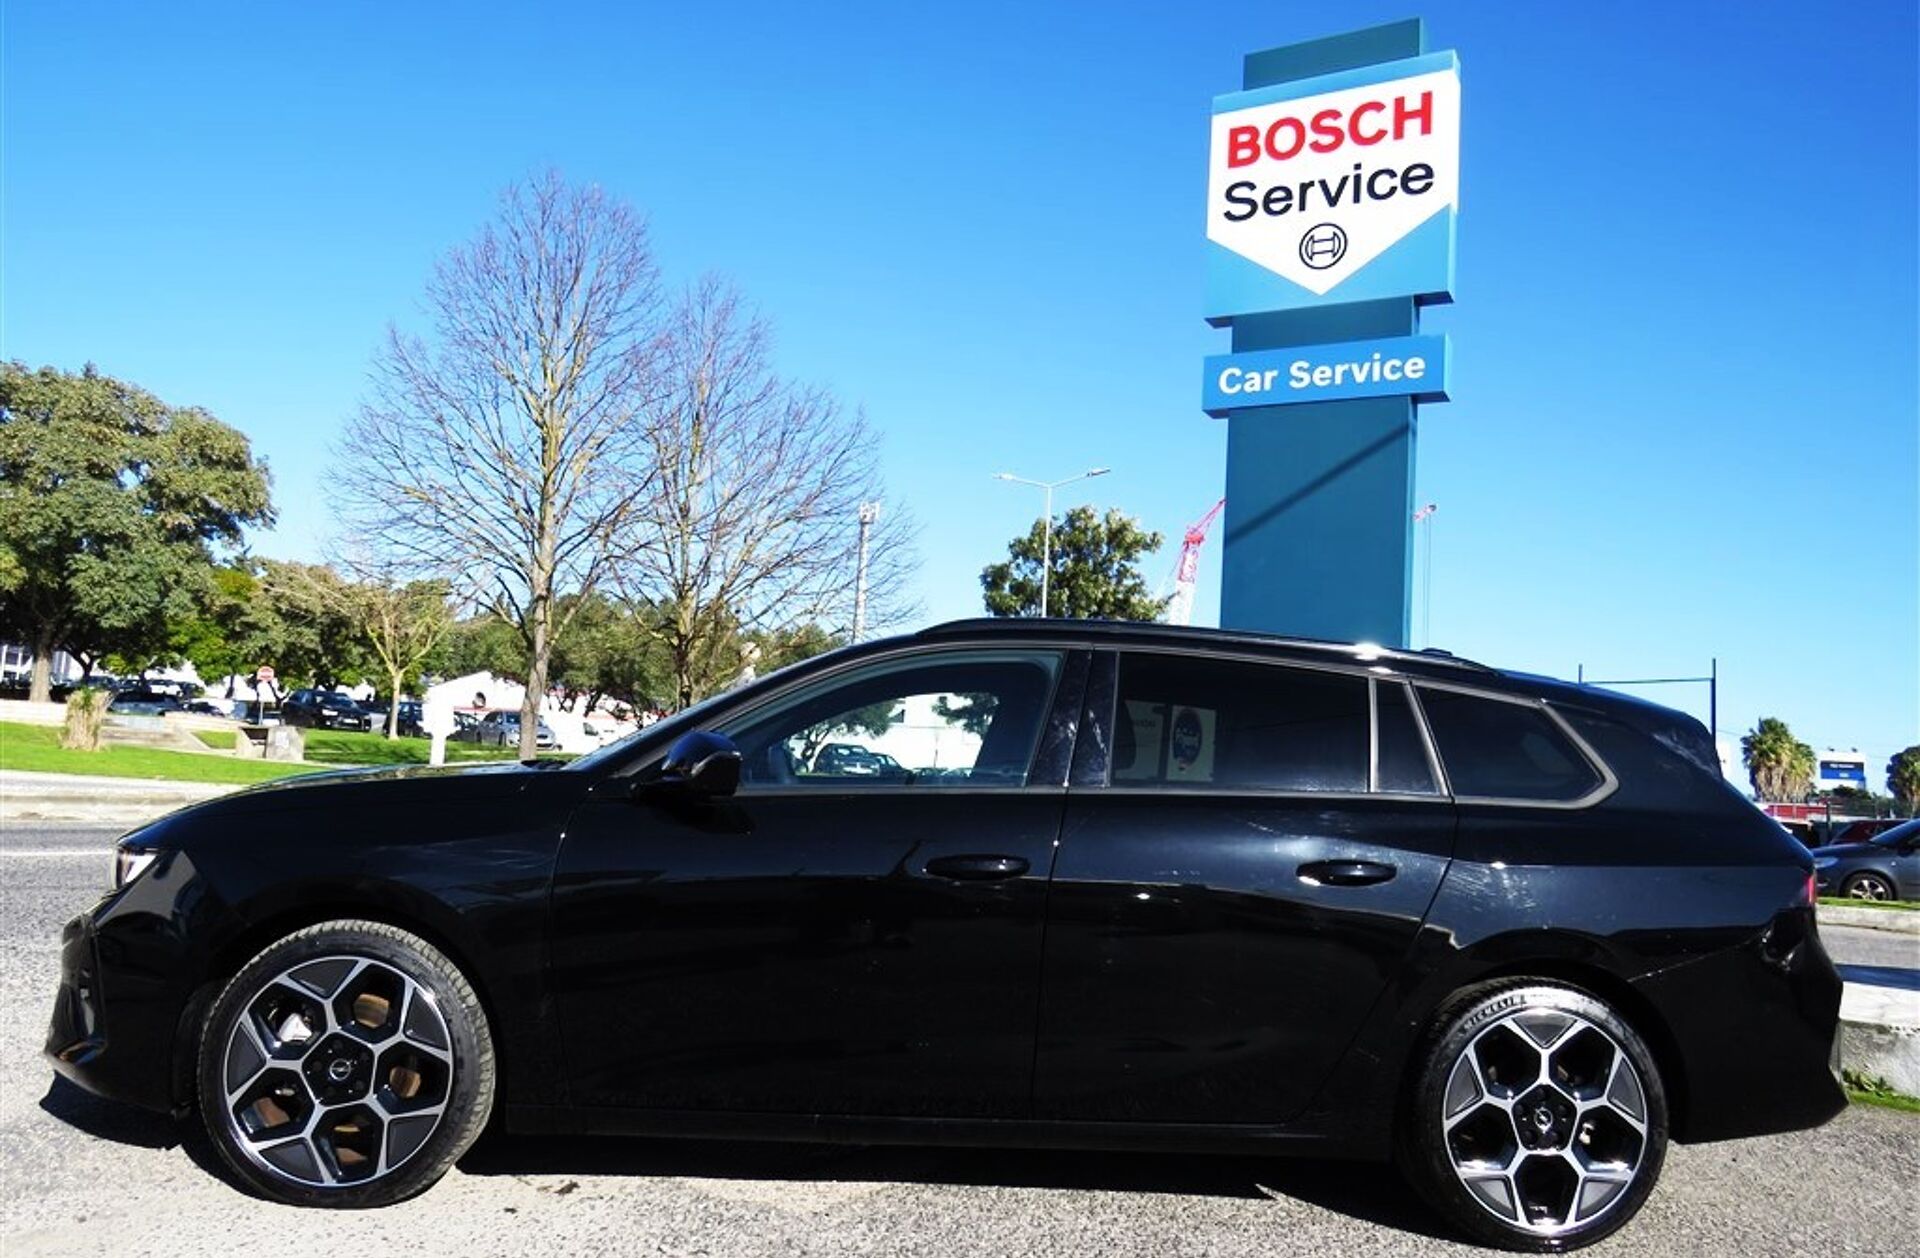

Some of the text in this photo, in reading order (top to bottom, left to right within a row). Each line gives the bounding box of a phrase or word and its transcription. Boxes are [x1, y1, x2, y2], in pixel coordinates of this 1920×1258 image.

[1227, 91, 1433, 168] BOSCH
[1223, 161, 1434, 222] Service
[1218, 354, 1426, 394] Car Service
